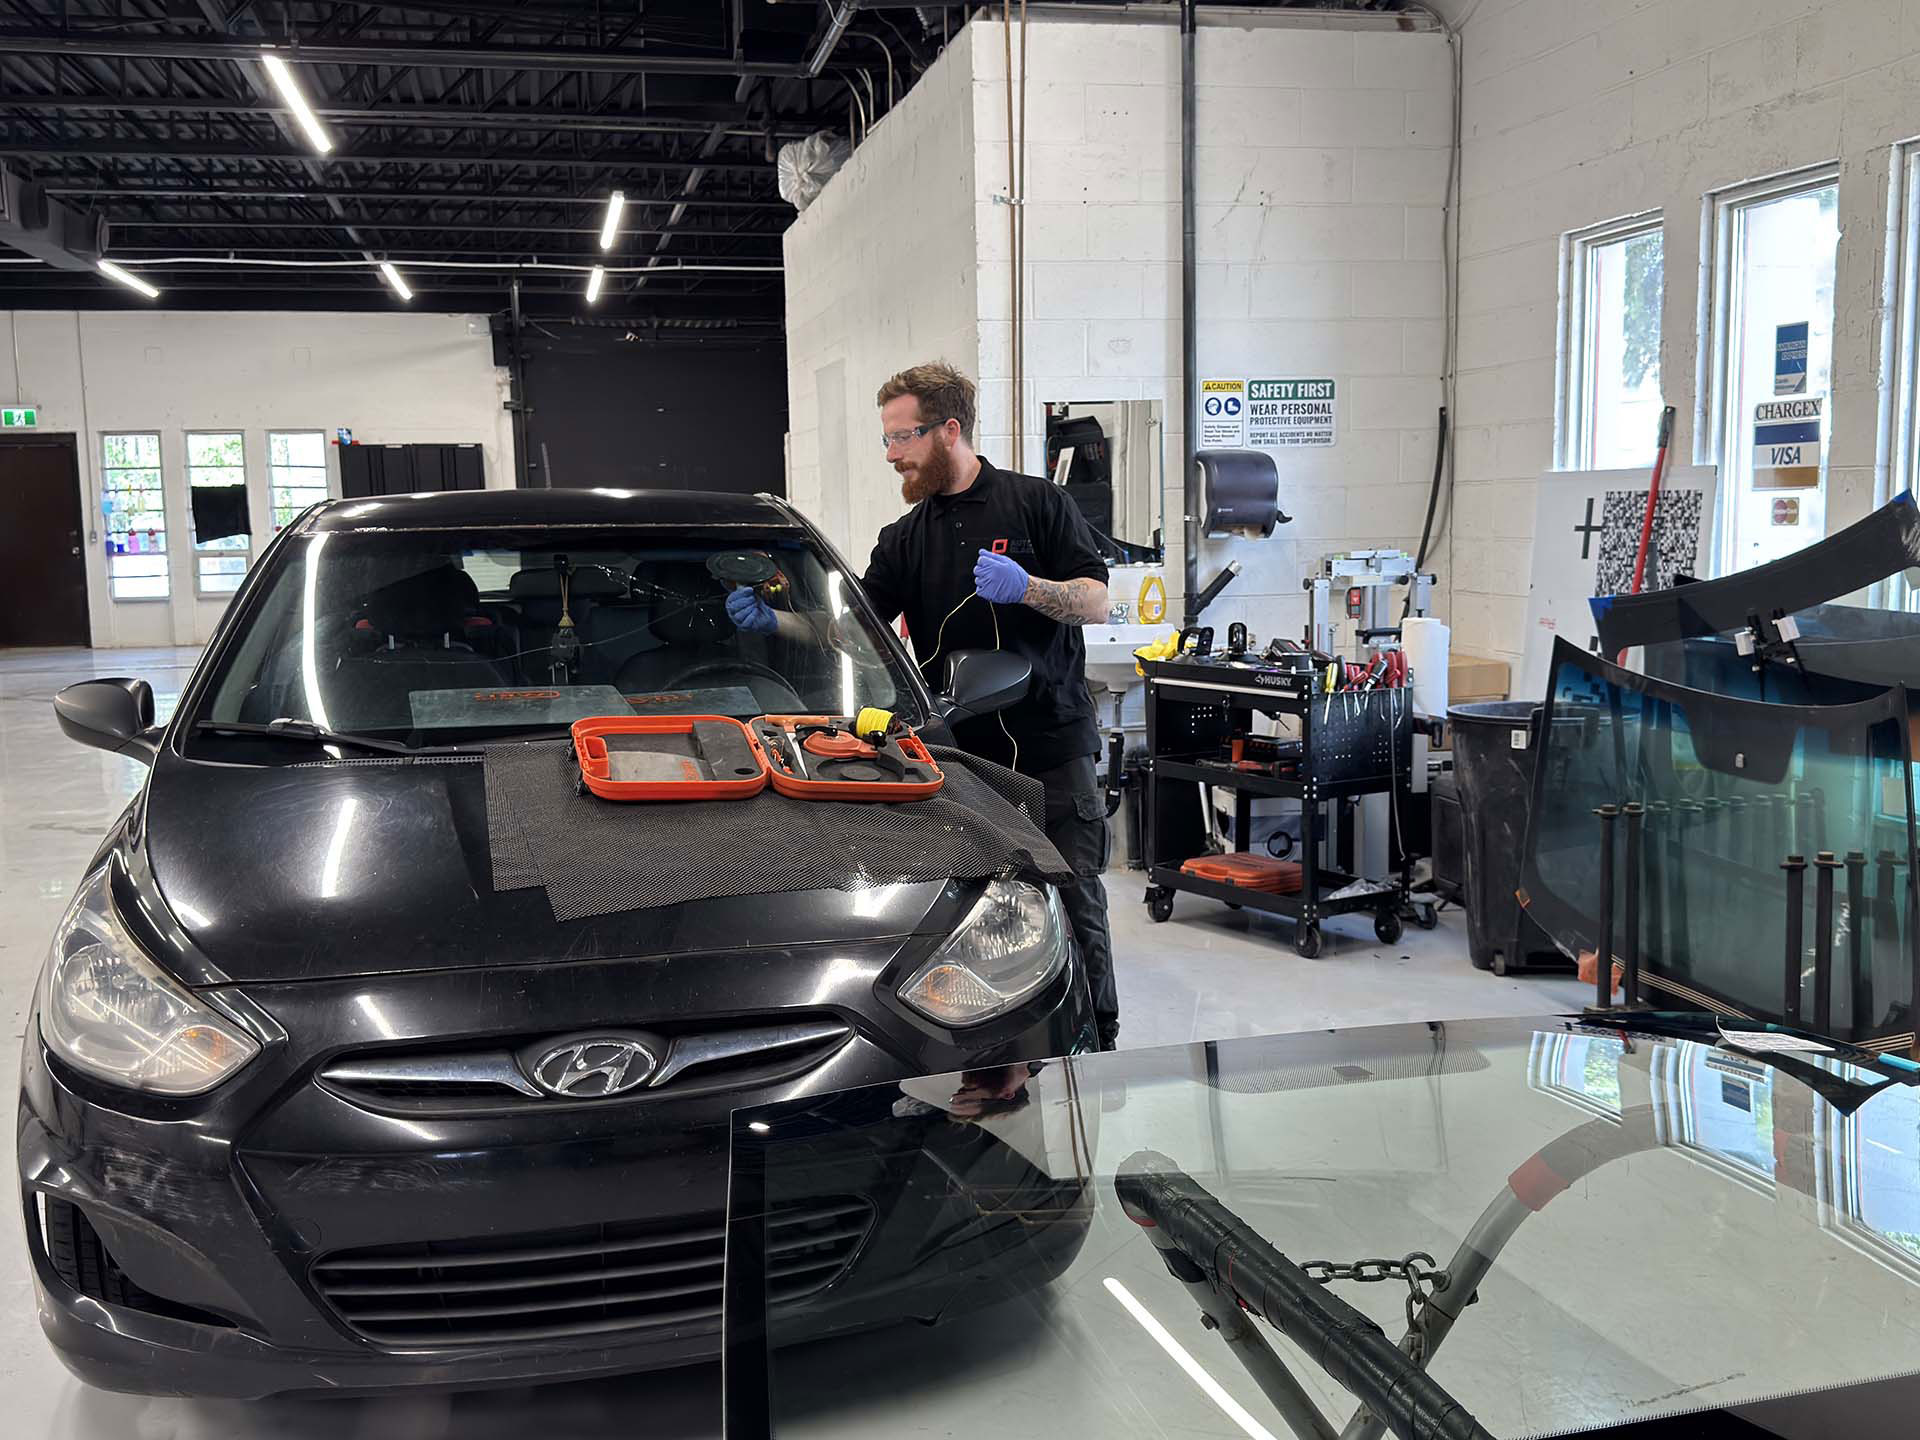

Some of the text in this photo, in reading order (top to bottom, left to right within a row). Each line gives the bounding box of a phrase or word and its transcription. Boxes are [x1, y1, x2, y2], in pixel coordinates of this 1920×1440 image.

[1251, 382, 1332, 399] SAFETY FIRST
[1250, 402, 1332, 415] WEAR PERSONAL
[1756, 400, 1820, 420] CHARGEX
[1250, 415, 1332, 425] PROTECTIVE EQUIPMENT
[1771, 446, 1801, 464] VISA
[1264, 675, 1292, 687] HUSKY
